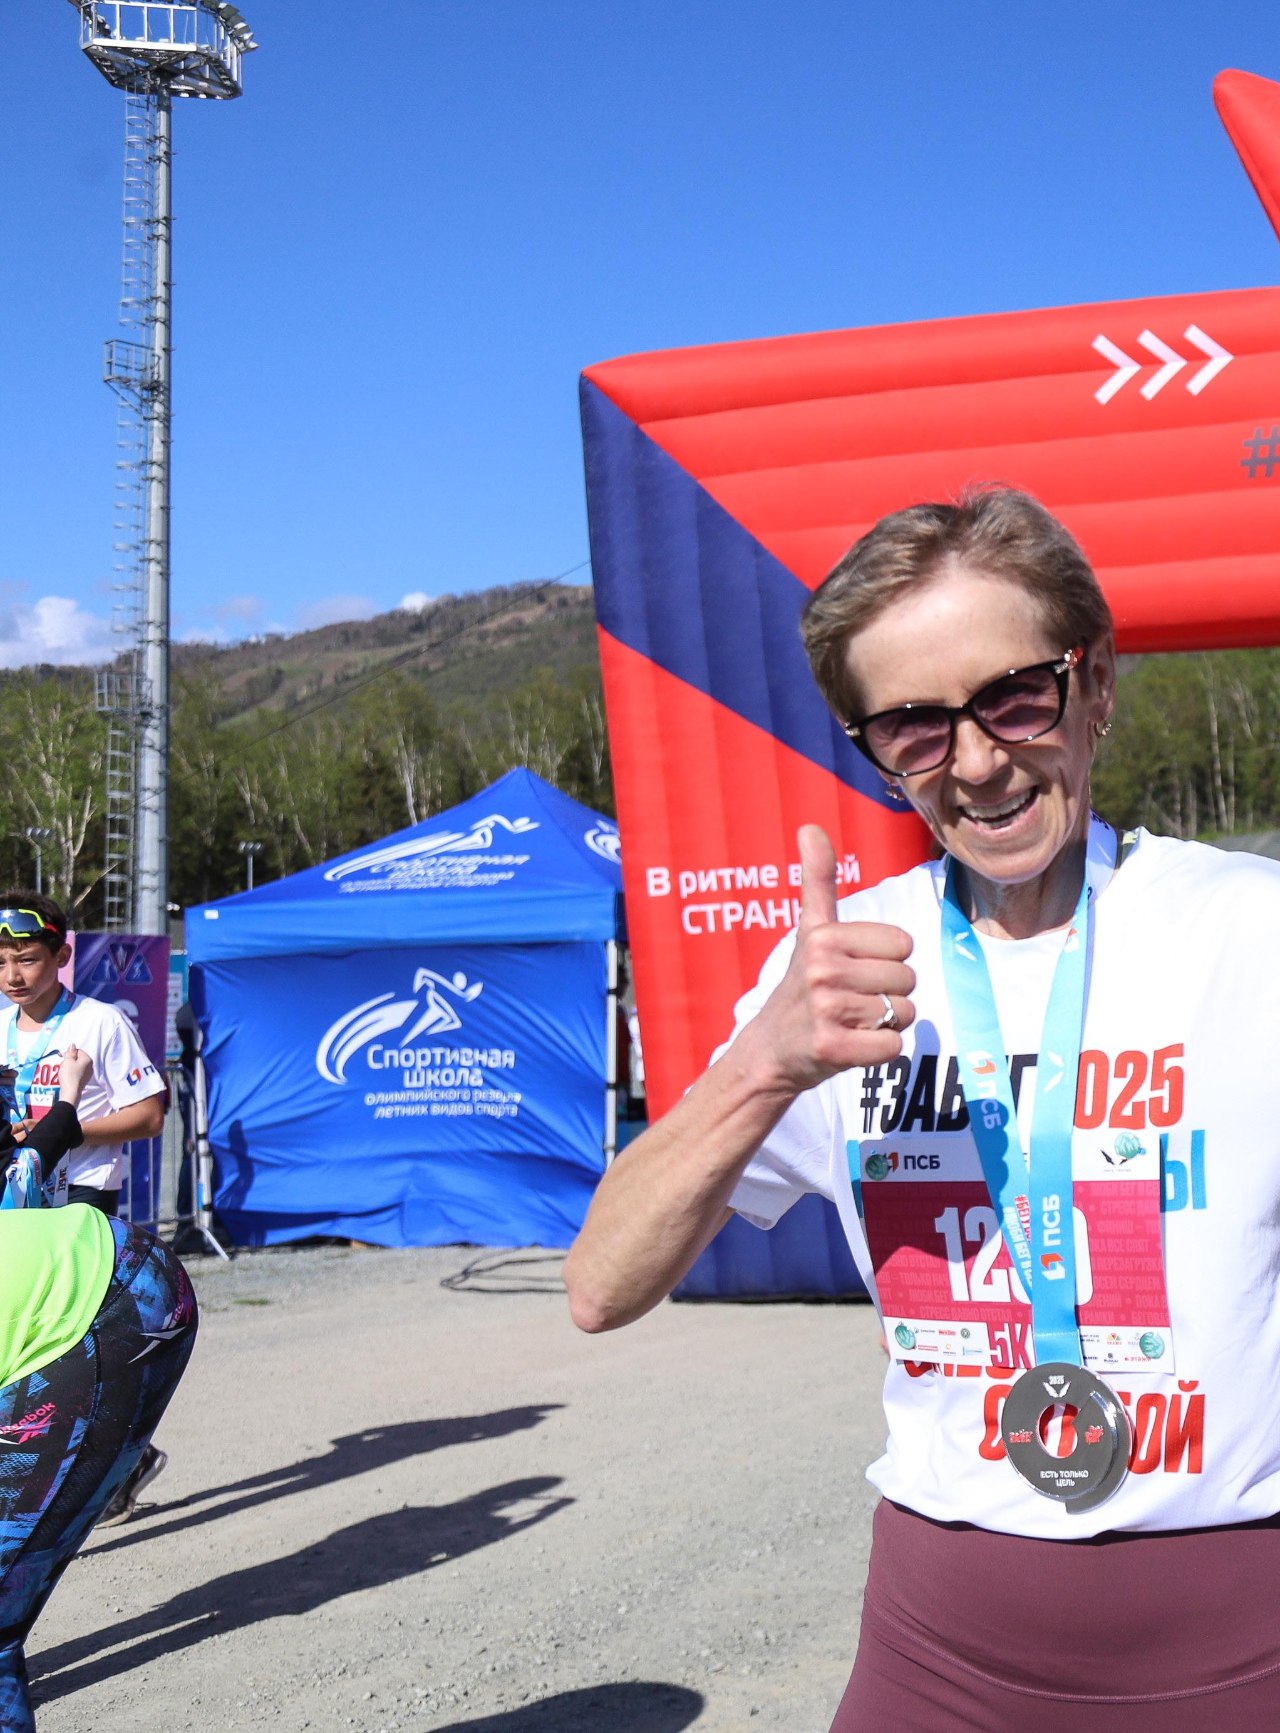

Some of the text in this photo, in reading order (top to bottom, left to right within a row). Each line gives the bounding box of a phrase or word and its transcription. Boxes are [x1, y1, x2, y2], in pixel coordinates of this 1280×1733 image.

[646, 854, 861, 899] В ритме вй
[367, 1044, 515, 1069] Спортивная
[403, 1067, 484, 1088] школа
[860, 1043, 1185, 1134] #ЗАБГ 025
[430, 1103, 473, 1117] видов
[904, 1155, 940, 1171] ПСБ
[1042, 1194, 1061, 1246] ПСБ
